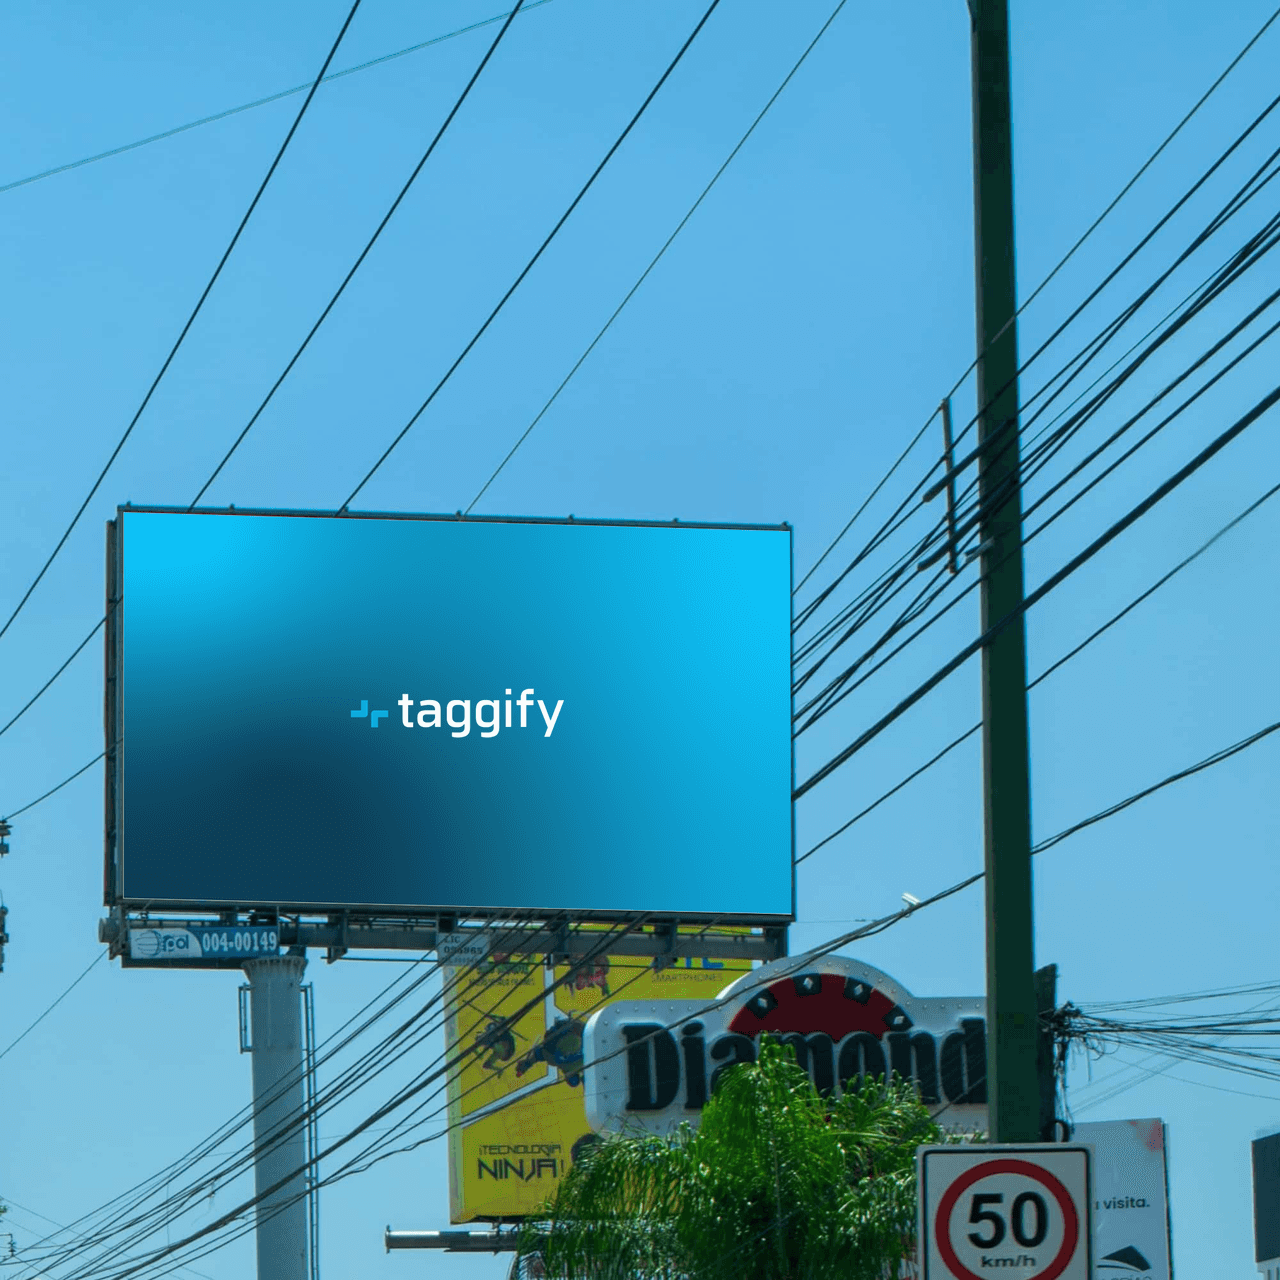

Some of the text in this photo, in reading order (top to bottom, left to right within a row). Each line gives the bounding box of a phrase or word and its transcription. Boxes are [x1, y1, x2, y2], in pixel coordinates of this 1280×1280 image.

[396, 688, 565, 739] taggify
[202, 931, 258, 953] 004-00149
[620, 1016, 987, 1111] Diamond
[477, 1158, 564, 1182] NINJA!
[1102, 1196, 1151, 1210] visita.
[967, 1191, 1049, 1250] 50
[981, 1255, 1037, 1268] km/h
